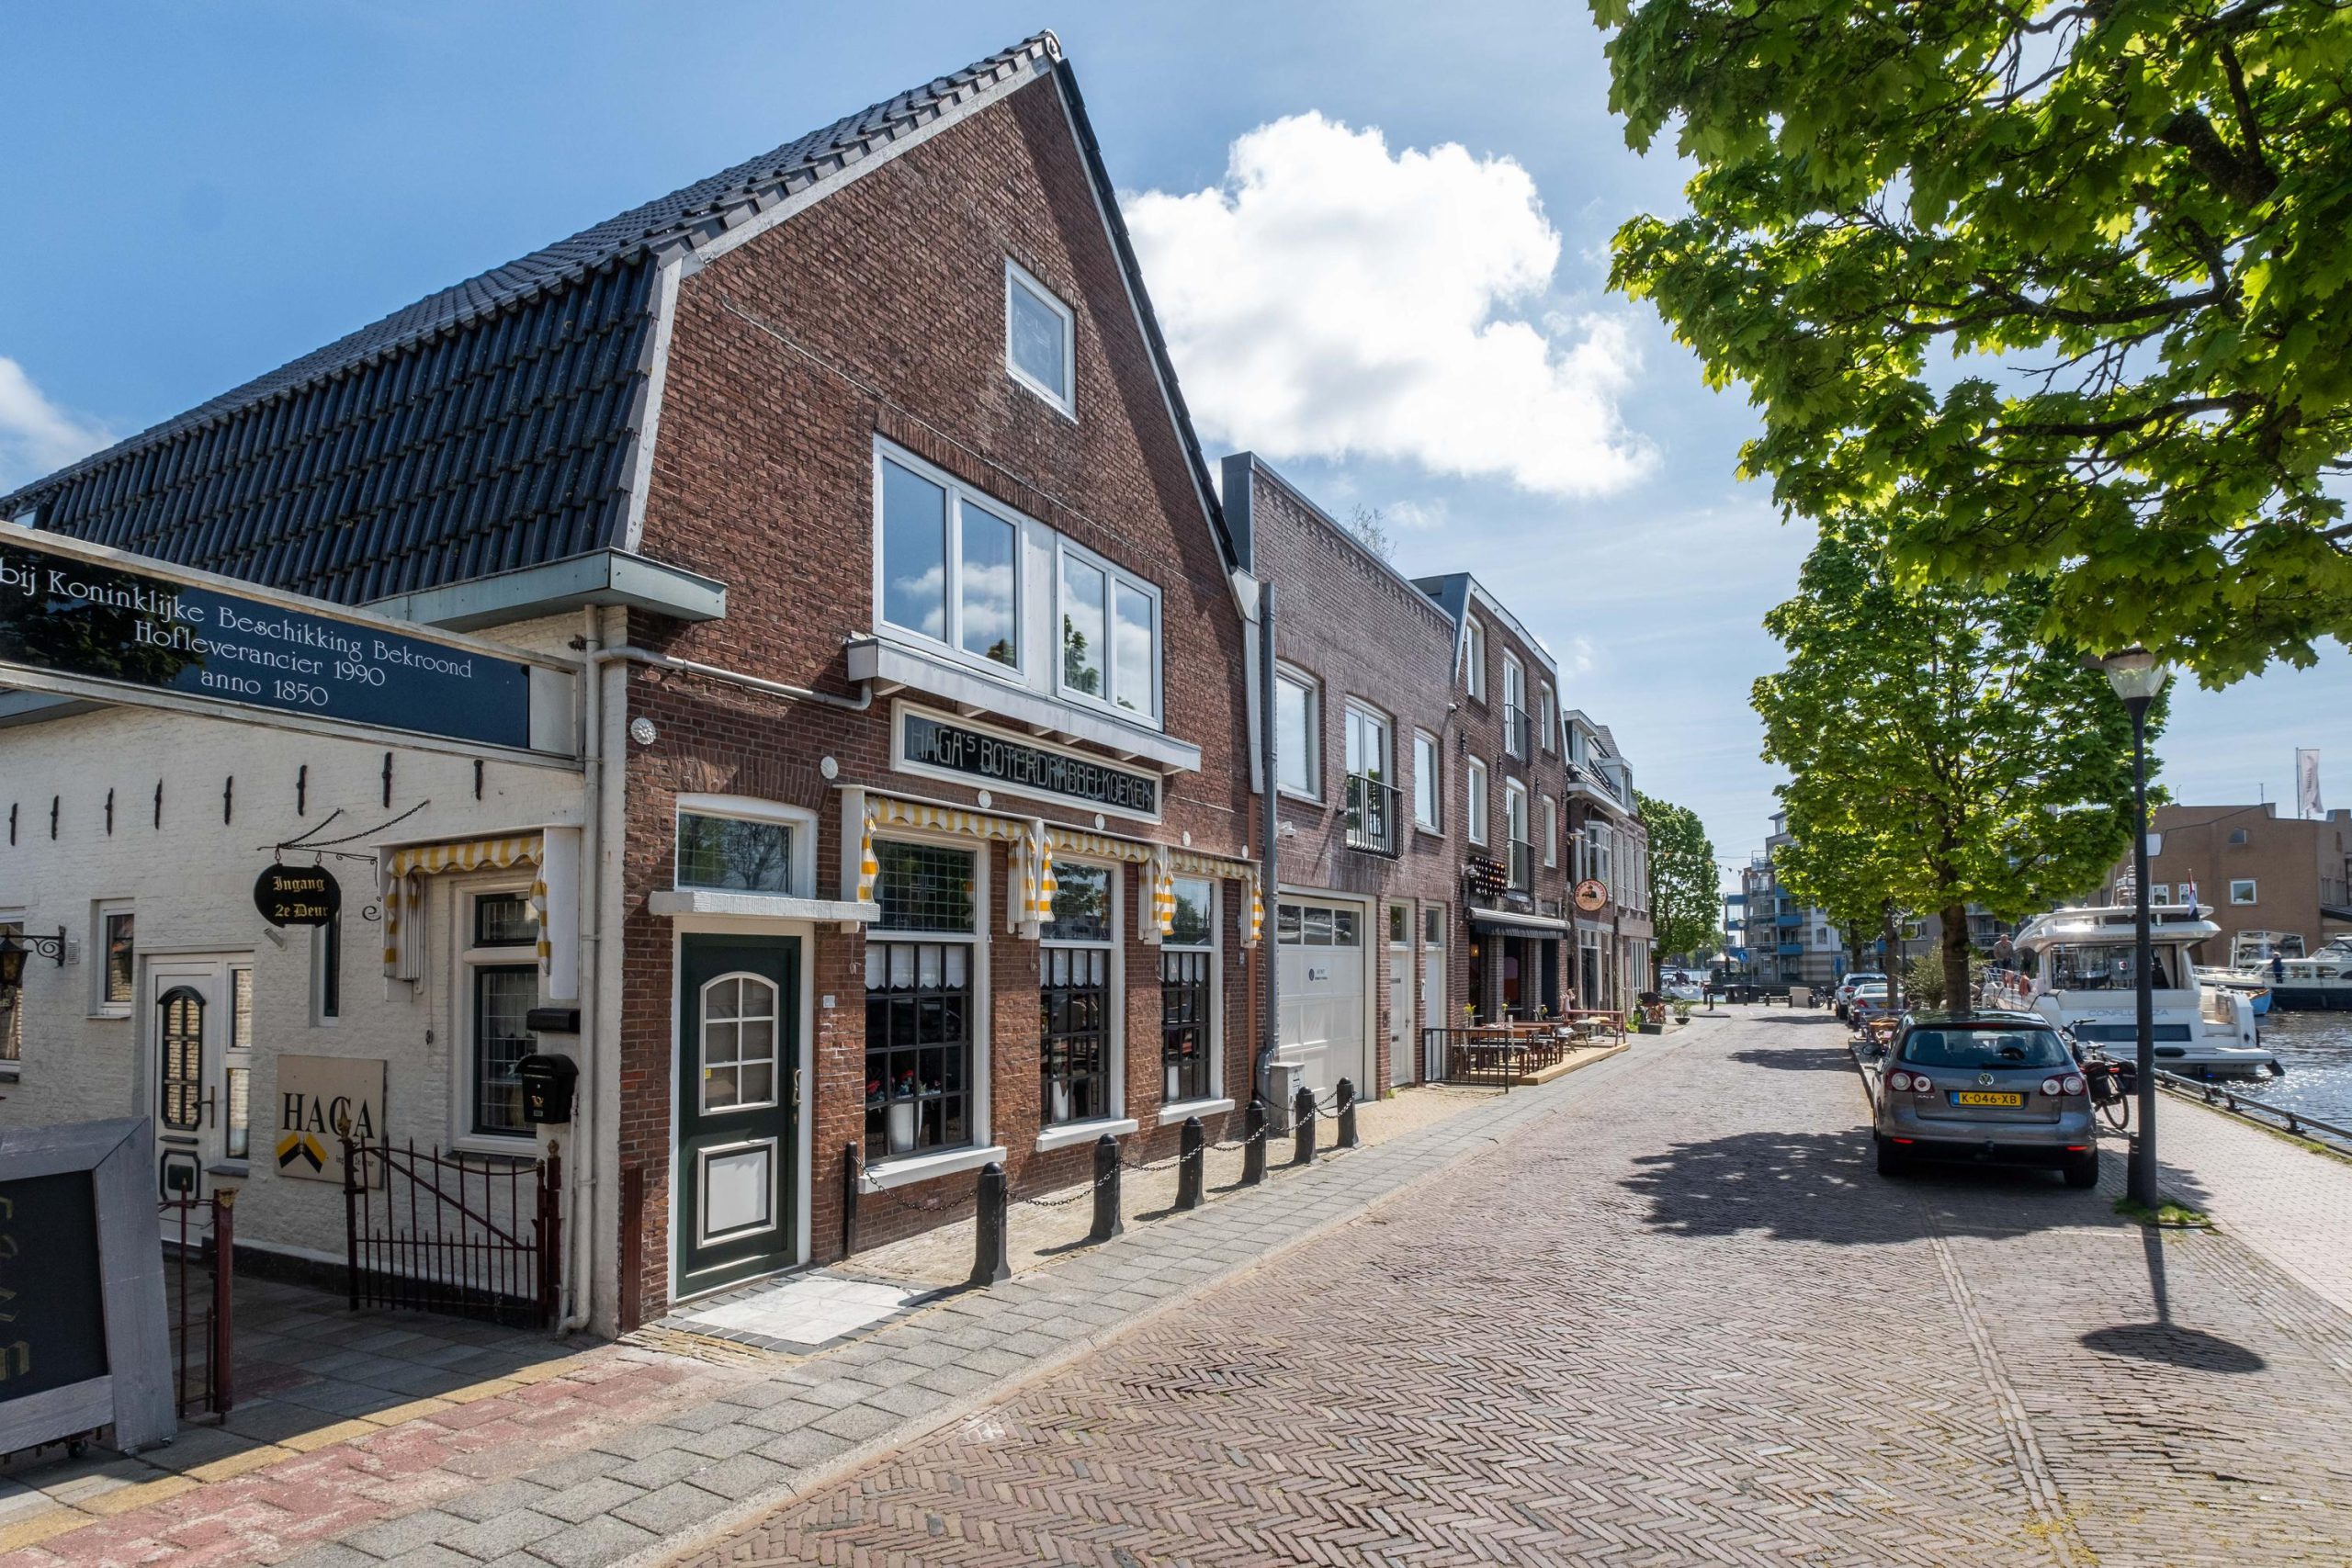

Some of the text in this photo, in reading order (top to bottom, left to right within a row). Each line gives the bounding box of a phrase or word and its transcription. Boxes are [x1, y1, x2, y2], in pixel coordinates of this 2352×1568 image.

[0, 558, 472, 678] bij Koninklijke Beschikking Bekroond
[134, 619, 386, 686] Hofleverancier 1990
[200, 669, 328, 706] anno 1850
[272, 875, 325, 893] Ingang
[275, 903, 328, 918] 2e Deur
[1962, 1093, 2018, 1103] K-046-XB
